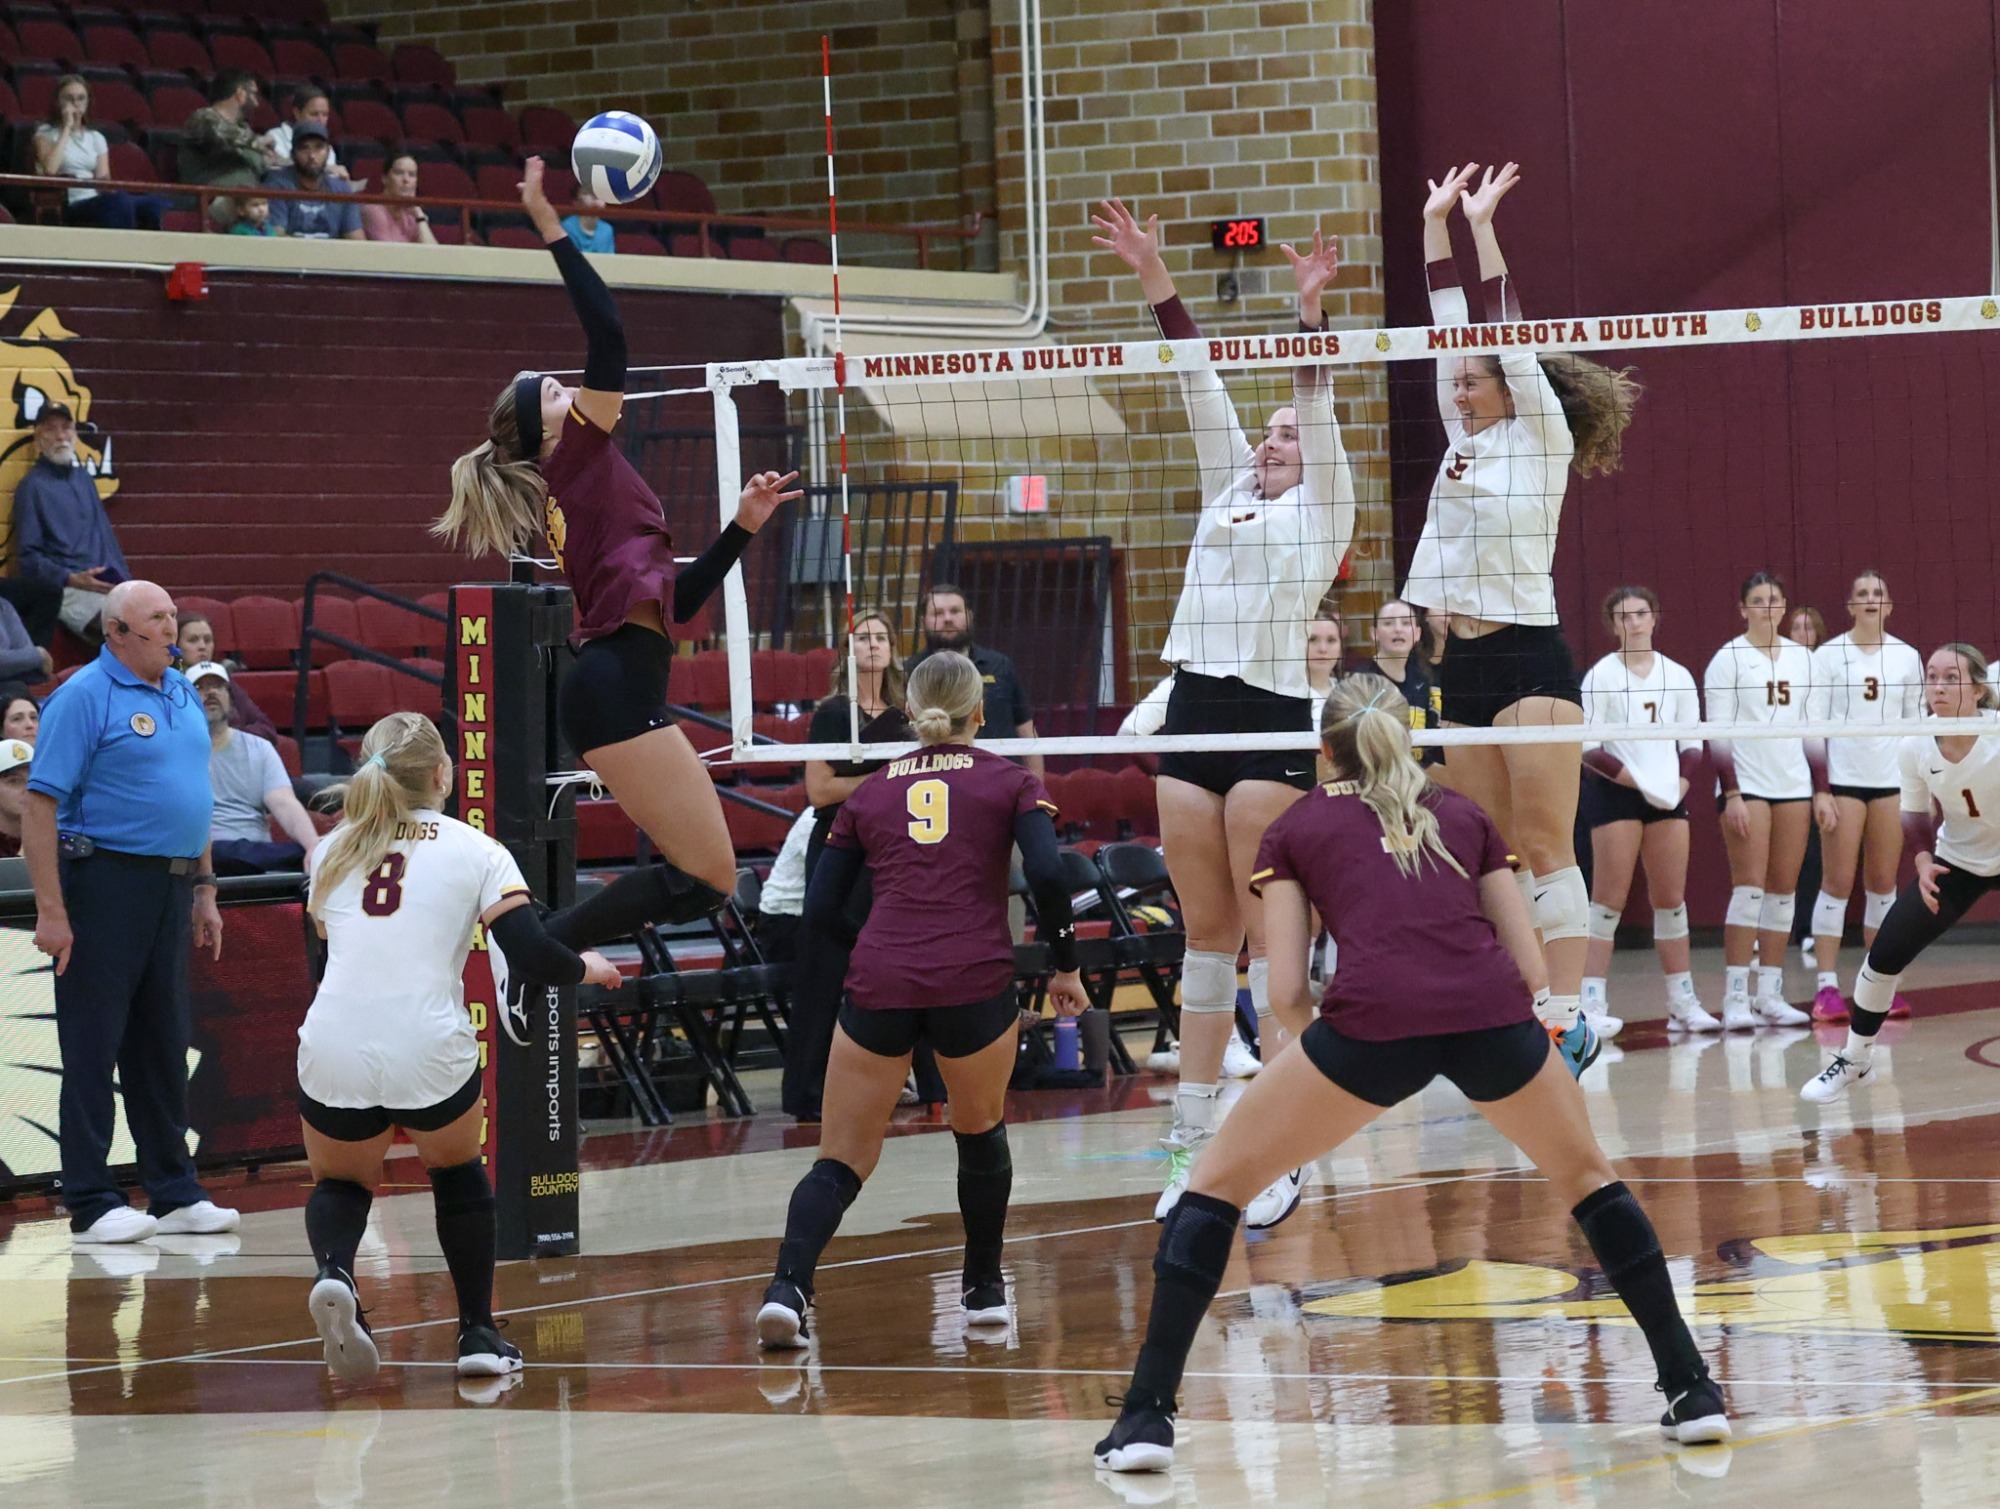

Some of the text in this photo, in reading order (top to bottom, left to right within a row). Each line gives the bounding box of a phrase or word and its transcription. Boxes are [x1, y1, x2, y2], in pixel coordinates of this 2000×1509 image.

[1224, 221, 1259, 247] 205
[864, 301, 1942, 378] MINNESOTA DULUTH BULLDOGS MINNESOTA DULUTH BULLDOGS
[1766, 681, 1790, 706] 15
[1863, 676, 1878, 701] 3
[1643, 701, 1657, 723] 7
[886, 753, 975, 780] BULLDOGS
[907, 778, 949, 844] 9
[1961, 788, 1981, 818] 1
[362, 851, 405, 917] 8
[531, 1172, 578, 1187] BULLDOG
[531, 1183, 578, 1197] COUNTRY
